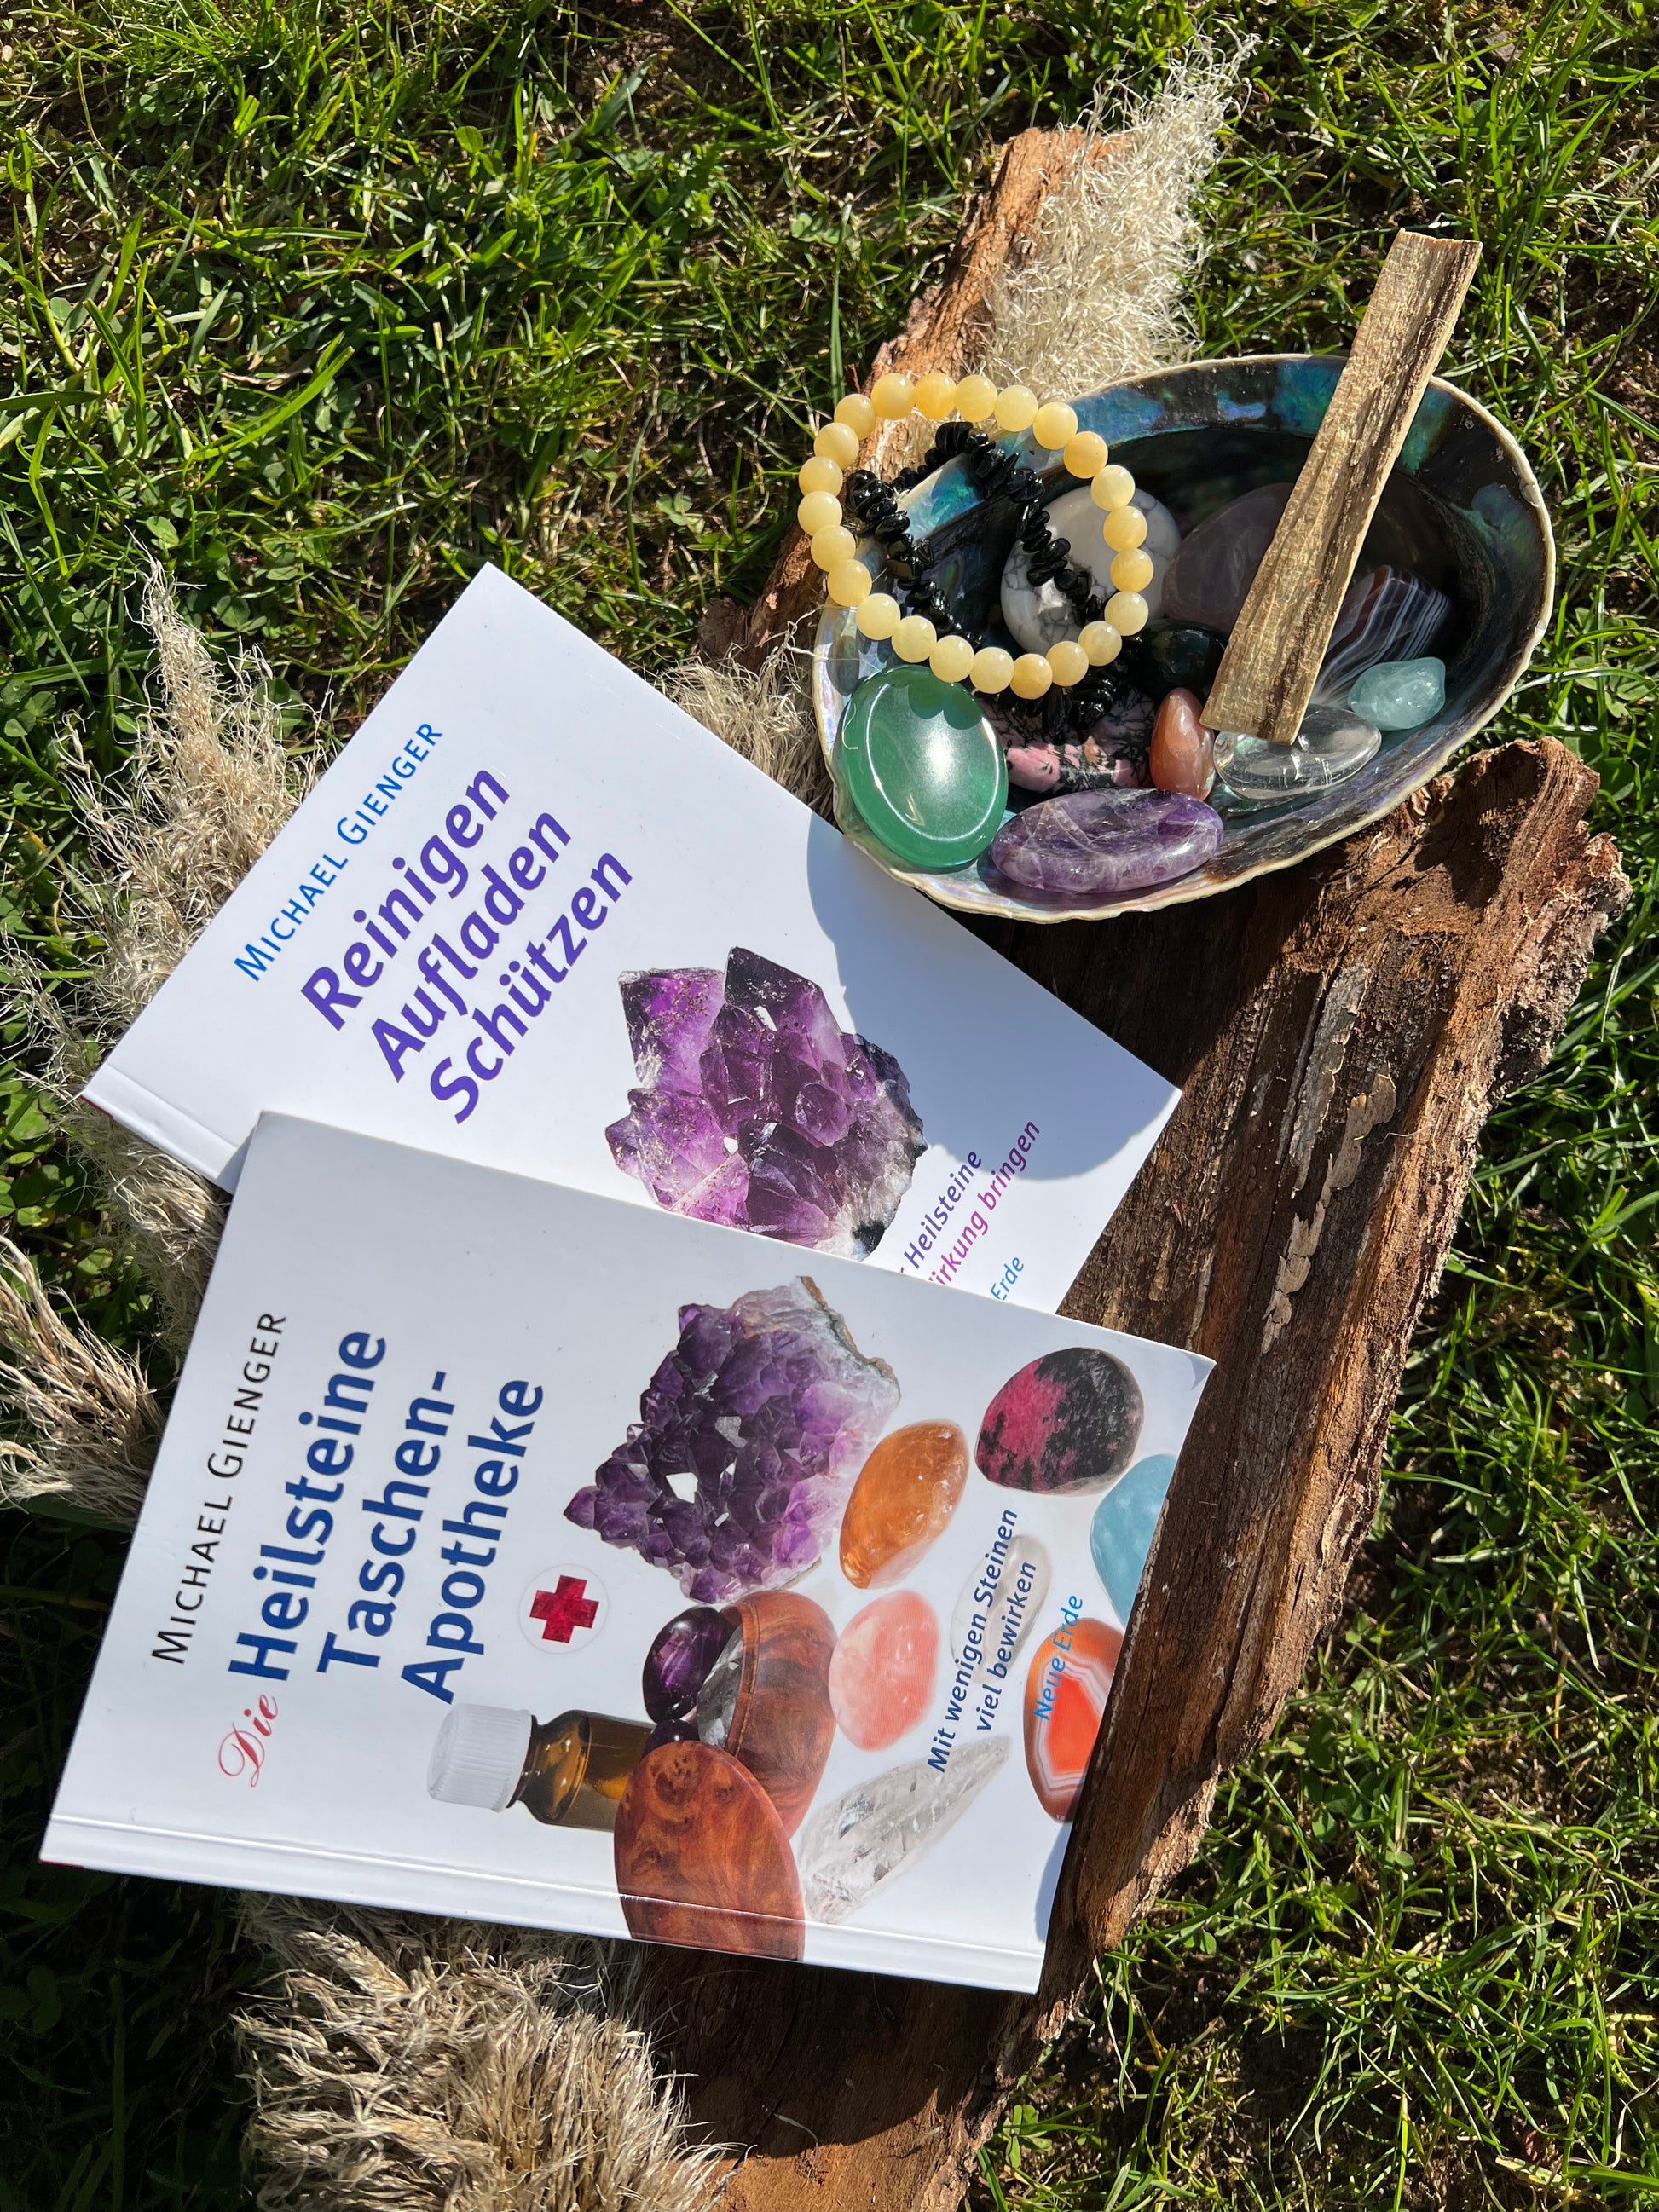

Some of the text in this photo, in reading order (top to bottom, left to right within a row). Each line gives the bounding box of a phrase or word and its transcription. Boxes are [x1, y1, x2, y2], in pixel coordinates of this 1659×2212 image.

[234, 723, 443, 982] MICHAEL GIENGER
[300, 770, 511, 1031] Reinigen
[370, 812, 572, 1083] Aufladen
[430, 852, 633, 1124] Schützen
[904, 1151, 982, 1268] Heilsteine
[928, 1121, 1040, 1285] irkung bringen
[991, 1257, 1024, 1300] Erde
[152, 1313, 286, 1664] MICHAEL GIENGER
[218, 1331, 386, 1788] Die Heilsteine
[317, 1371, 456, 1673] Taschen-
[401, 1379, 544, 1705] Apotheke
[927, 1508, 1018, 1773] Mit wenigen Steinen
[977, 1561, 1037, 1733] viel bewirken
[1033, 1594, 1083, 1721] Neue Erde
